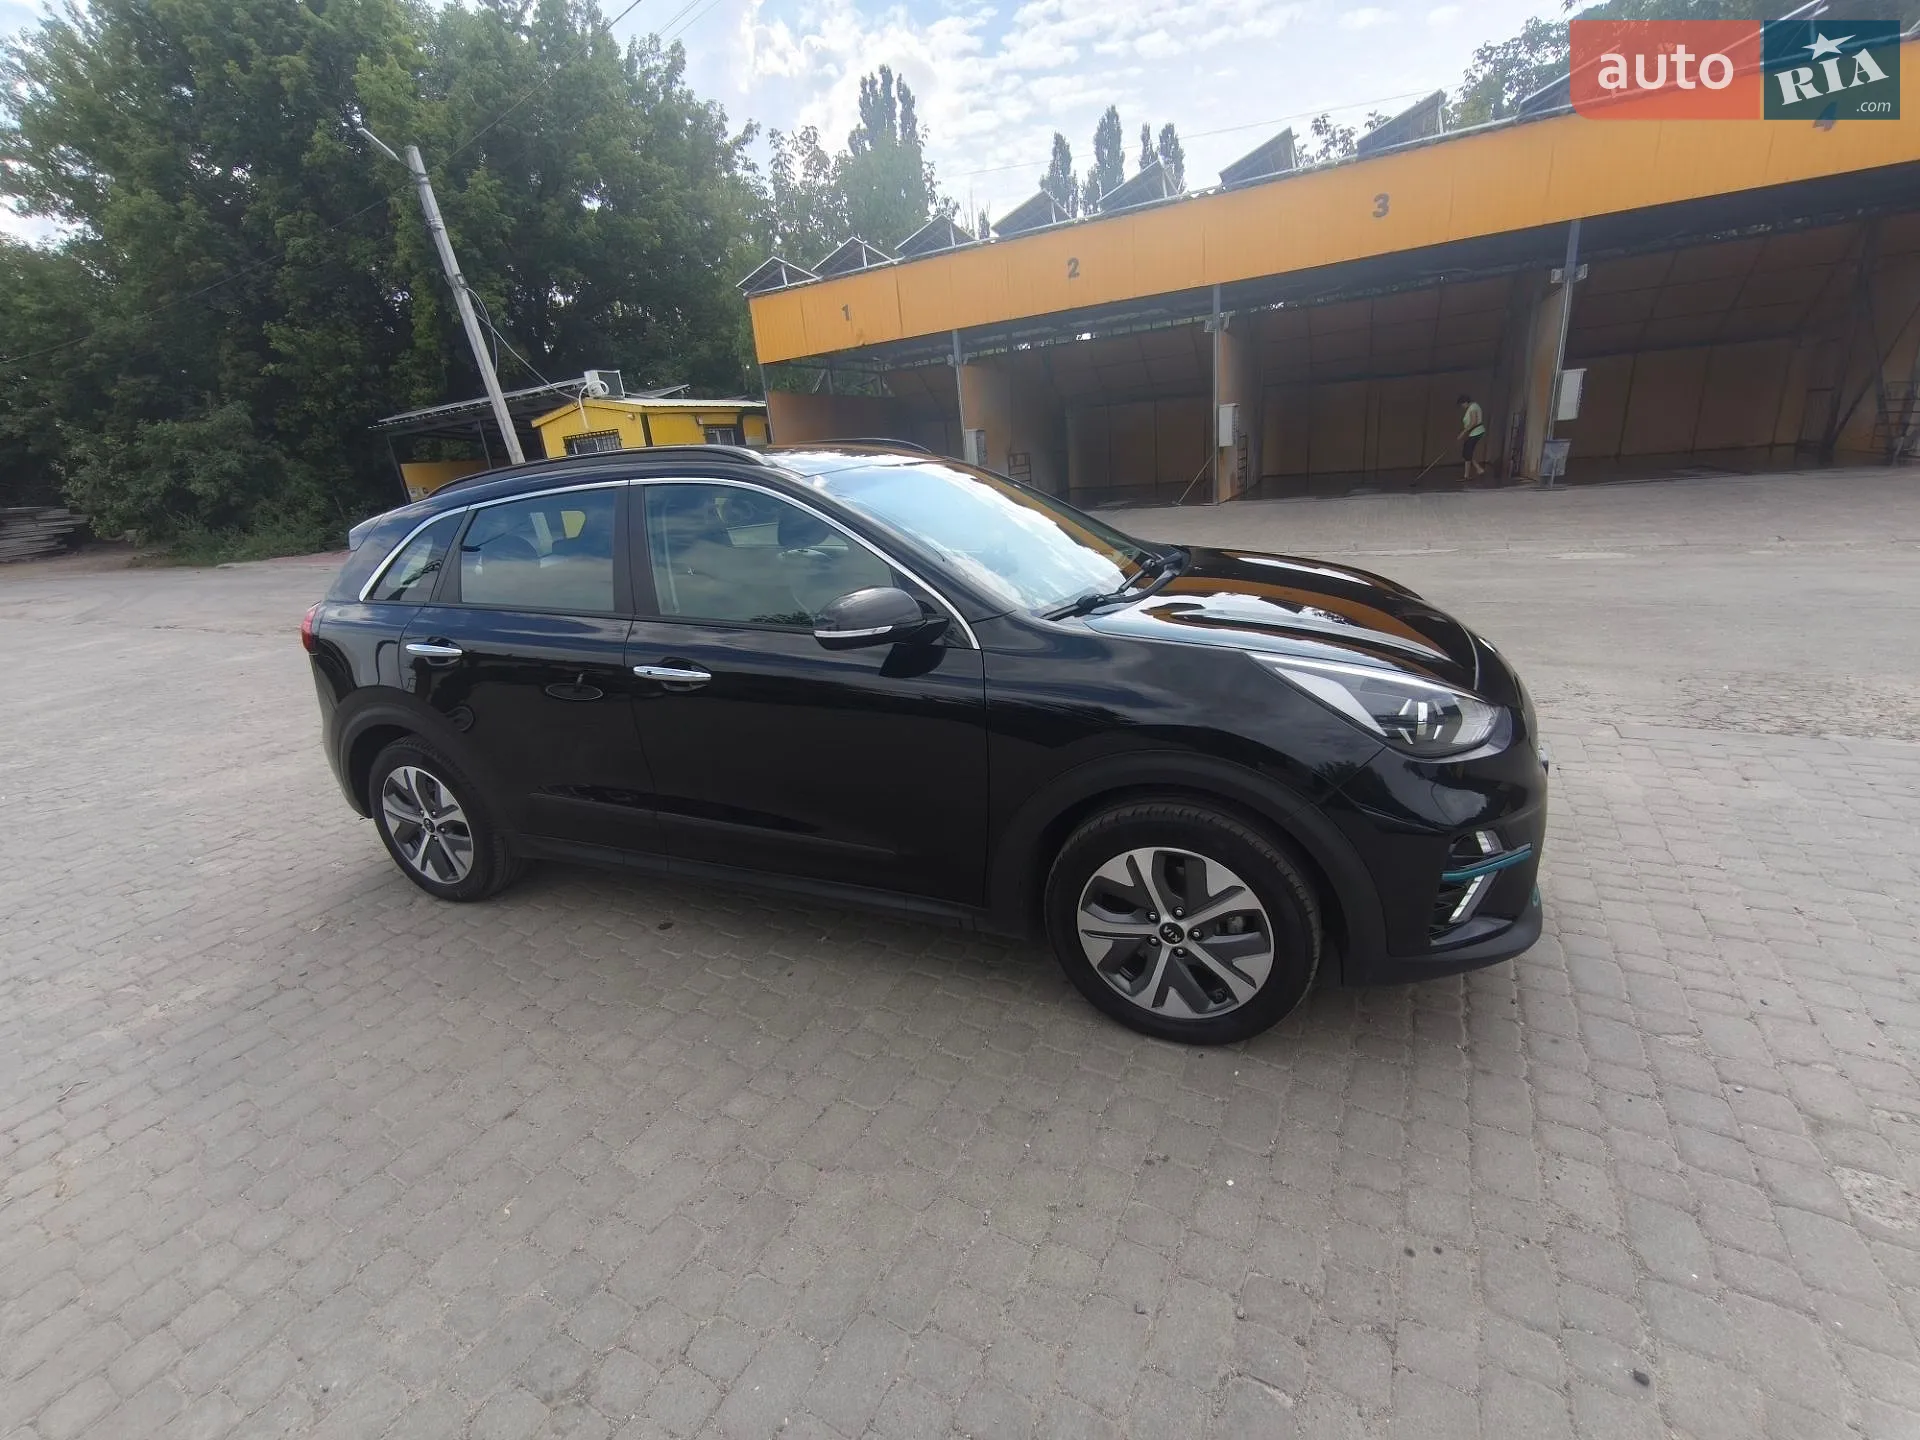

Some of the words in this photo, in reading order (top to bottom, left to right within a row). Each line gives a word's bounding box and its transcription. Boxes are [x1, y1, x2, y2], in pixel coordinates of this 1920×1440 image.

[1372, 193, 1389, 218] 3
[1067, 257, 1080, 279] 2
[842, 304, 850, 321] 1
